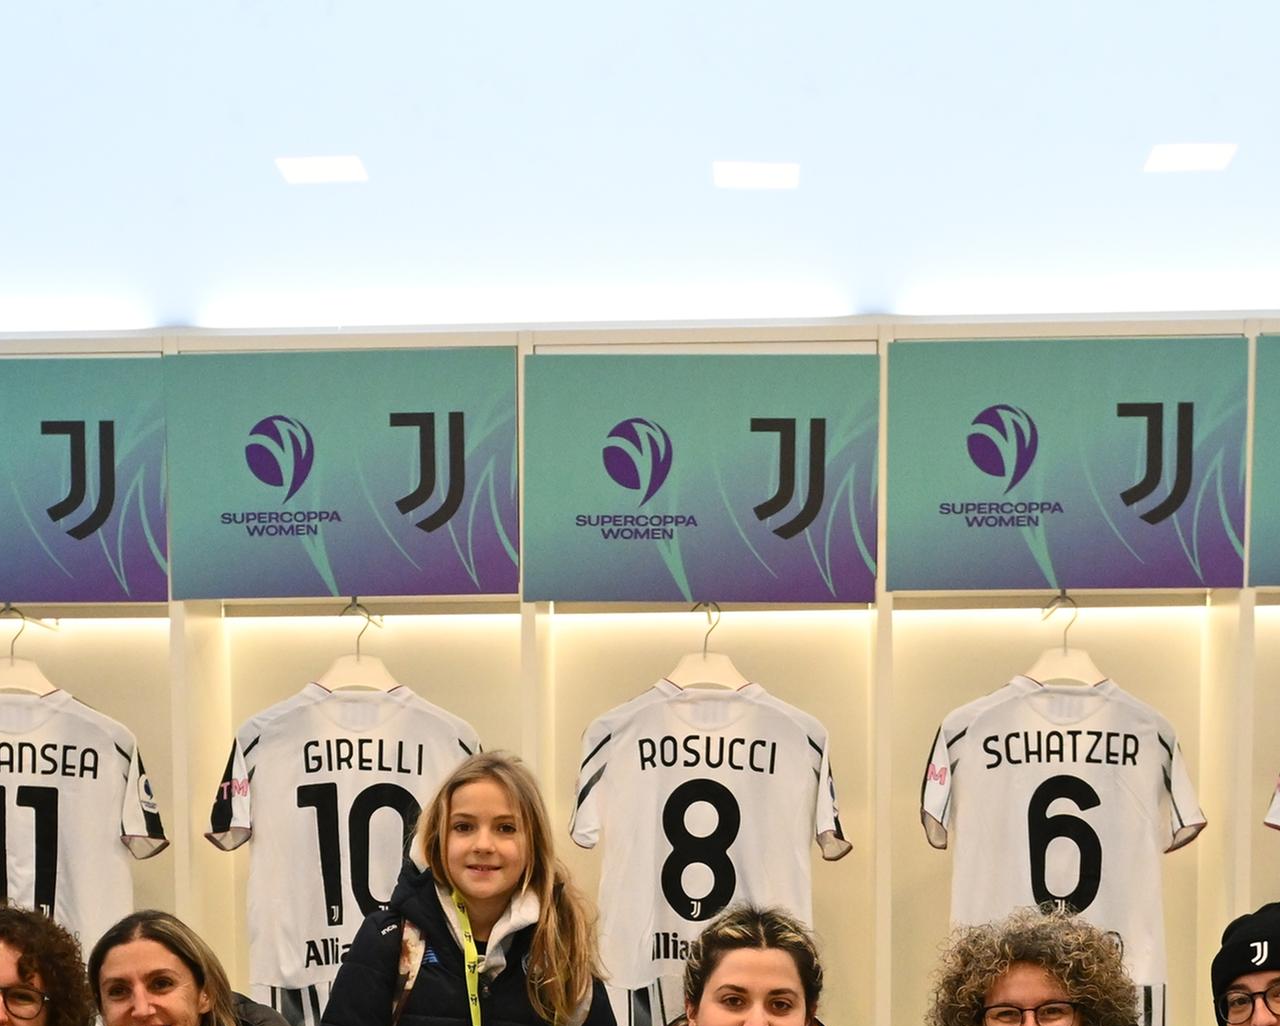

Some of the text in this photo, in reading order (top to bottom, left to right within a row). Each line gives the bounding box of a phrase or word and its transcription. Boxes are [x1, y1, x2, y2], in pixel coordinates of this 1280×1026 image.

[220, 510, 342, 526] SUPERCOPPA
[575, 514, 698, 528] SUPERCOPPA
[939, 502, 1064, 516] SUPERCOPPA
[964, 514, 1039, 528] WOMEN
[246, 523, 319, 538] WOMEN
[601, 527, 674, 540] WOMEN
[303, 738, 423, 775] GIRELLI
[638, 735, 777, 775] ROSUCCI
[982, 730, 1140, 769] SCHATZER
[297, 783, 422, 926] 10
[661, 778, 741, 923] 8
[1028, 774, 1102, 917] 6
